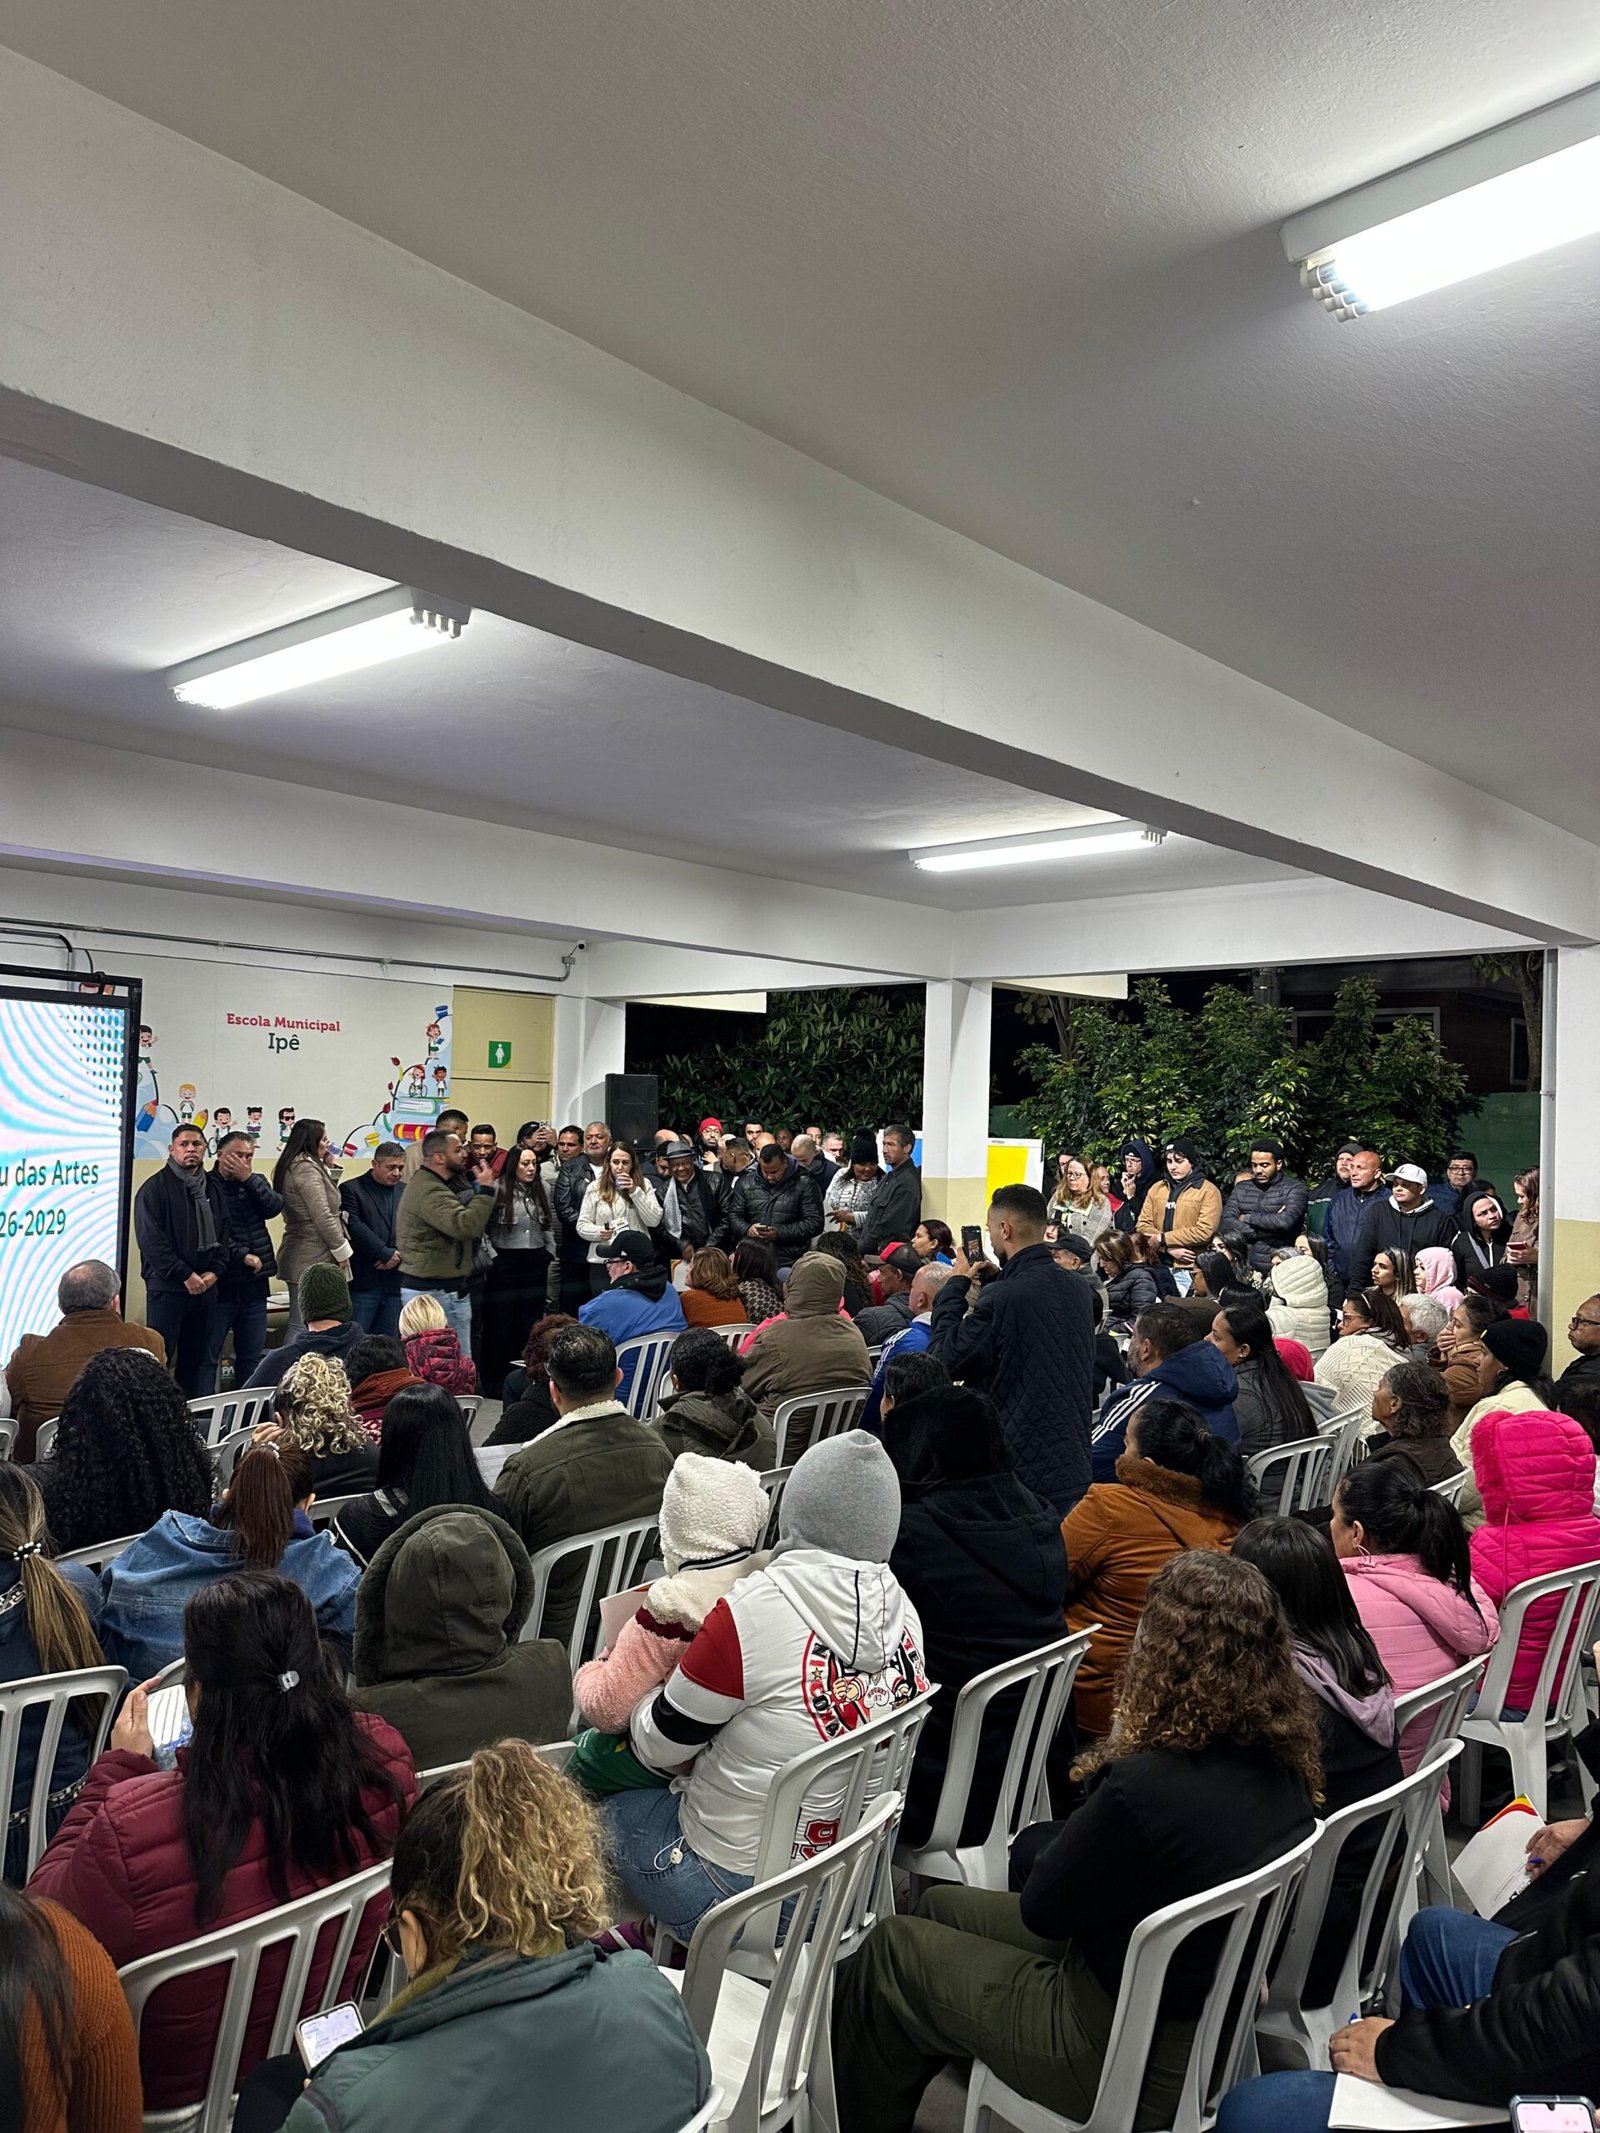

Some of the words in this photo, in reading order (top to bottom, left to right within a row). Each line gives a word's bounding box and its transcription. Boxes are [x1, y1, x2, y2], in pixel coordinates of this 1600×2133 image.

[226, 1013, 271, 1027] Escola
[274, 1016, 341, 1033] Municipal
[268, 1032, 300, 1054] Ipê
[15, 1158, 47, 1187] das
[51, 1160, 99, 1186] Artes
